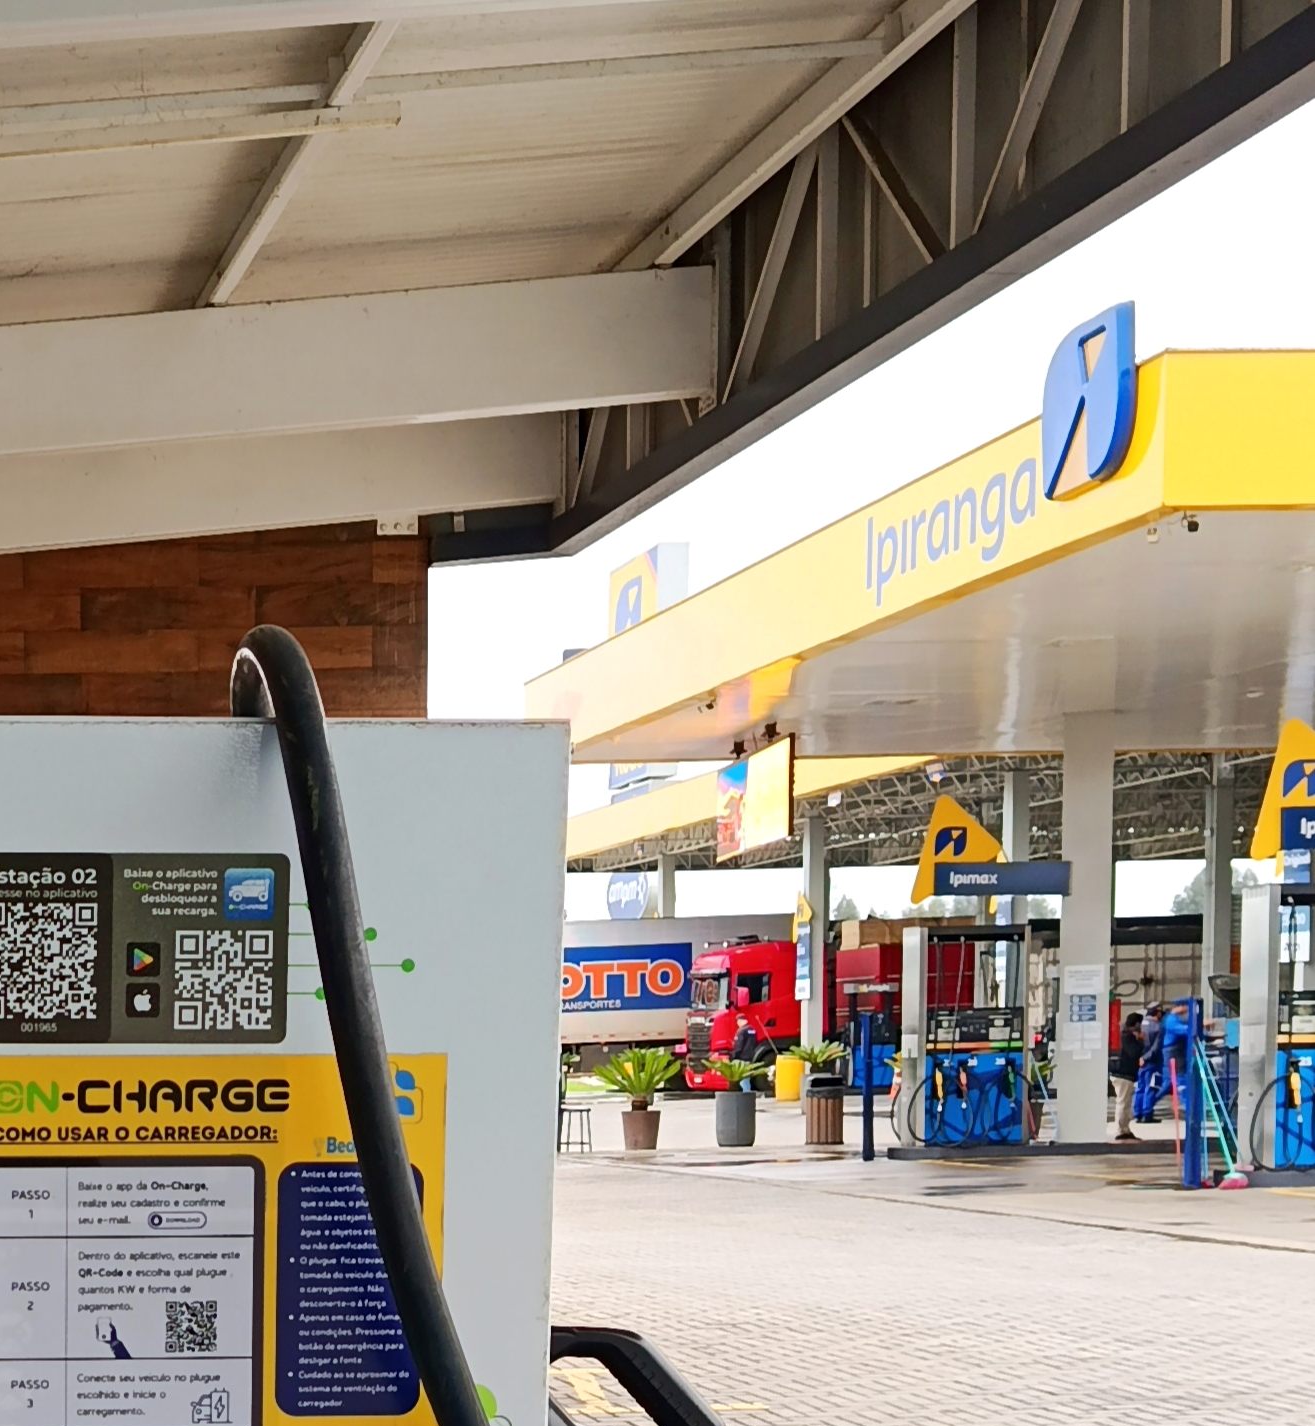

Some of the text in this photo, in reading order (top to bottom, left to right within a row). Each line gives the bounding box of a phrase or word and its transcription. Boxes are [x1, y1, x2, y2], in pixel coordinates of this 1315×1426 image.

[866, 458, 1036, 607] Ipiranga
[72, 869, 97, 884] 02
[124, 869, 217, 880] Baixe o aplicativo
[950, 871, 998, 887] Ipimax
[133, 881, 217, 892] On-Charge para
[28, 889, 39, 897] no
[43, 888, 97, 899] aplicativo
[142, 893, 207, 905] desbloquear
[173, 907, 217, 918] recarga.
[21, 1023, 57, 1032] 001965
[57, 1127, 109, 1142] USAR
[115, 1126, 130, 1141] O
[136, 1125, 278, 1141] CARREGADOR:
[301, 1170, 337, 1178] Antes de
[78, 1182, 102, 1191] Baixe
[116, 1183, 132, 1191] app
[137, 1181, 147, 1190] da
[151, 1181, 208, 1192] On-Charge,
[12, 1190, 50, 1200] PASSO
[78, 1199, 107, 1208] realize
[130, 1199, 170, 1207] cadastro
[183, 1199, 225, 1207] confirme
[97, 1216, 131, 1224] e-mail.
[79, 1252, 110, 1260] Dentro
[130, 1251, 175, 1261] aplicativo,
[79, 1268, 123, 1278] QR-Code
[136, 1268, 170, 1276] escolha
[174, 1268, 193, 1278] qual
[196, 1268, 227, 1278] plugue
[333, 1271, 343, 1279] do
[12, 1282, 50, 1291] PASSO
[79, 1286, 114, 1295] quantos
[148, 1285, 176, 1293] forma
[180, 1285, 191, 1293] de
[27, 1302, 33, 1310] 2
[78, 1303, 133, 1312] pagamento.
[299, 1314, 329, 1323] Apenas
[366, 1313, 376, 1321] de
[325, 1342, 335, 1350] de
[77, 1374, 115, 1382] Conecte
[190, 1374, 220, 1383] plugue
[11, 1380, 49, 1389] PASSO
[387, 1384, 397, 1392] do
[77, 1391, 120, 1399] escolhido
[27, 1399, 33, 1408] 3
[77, 1408, 145, 1417] carregamento.
